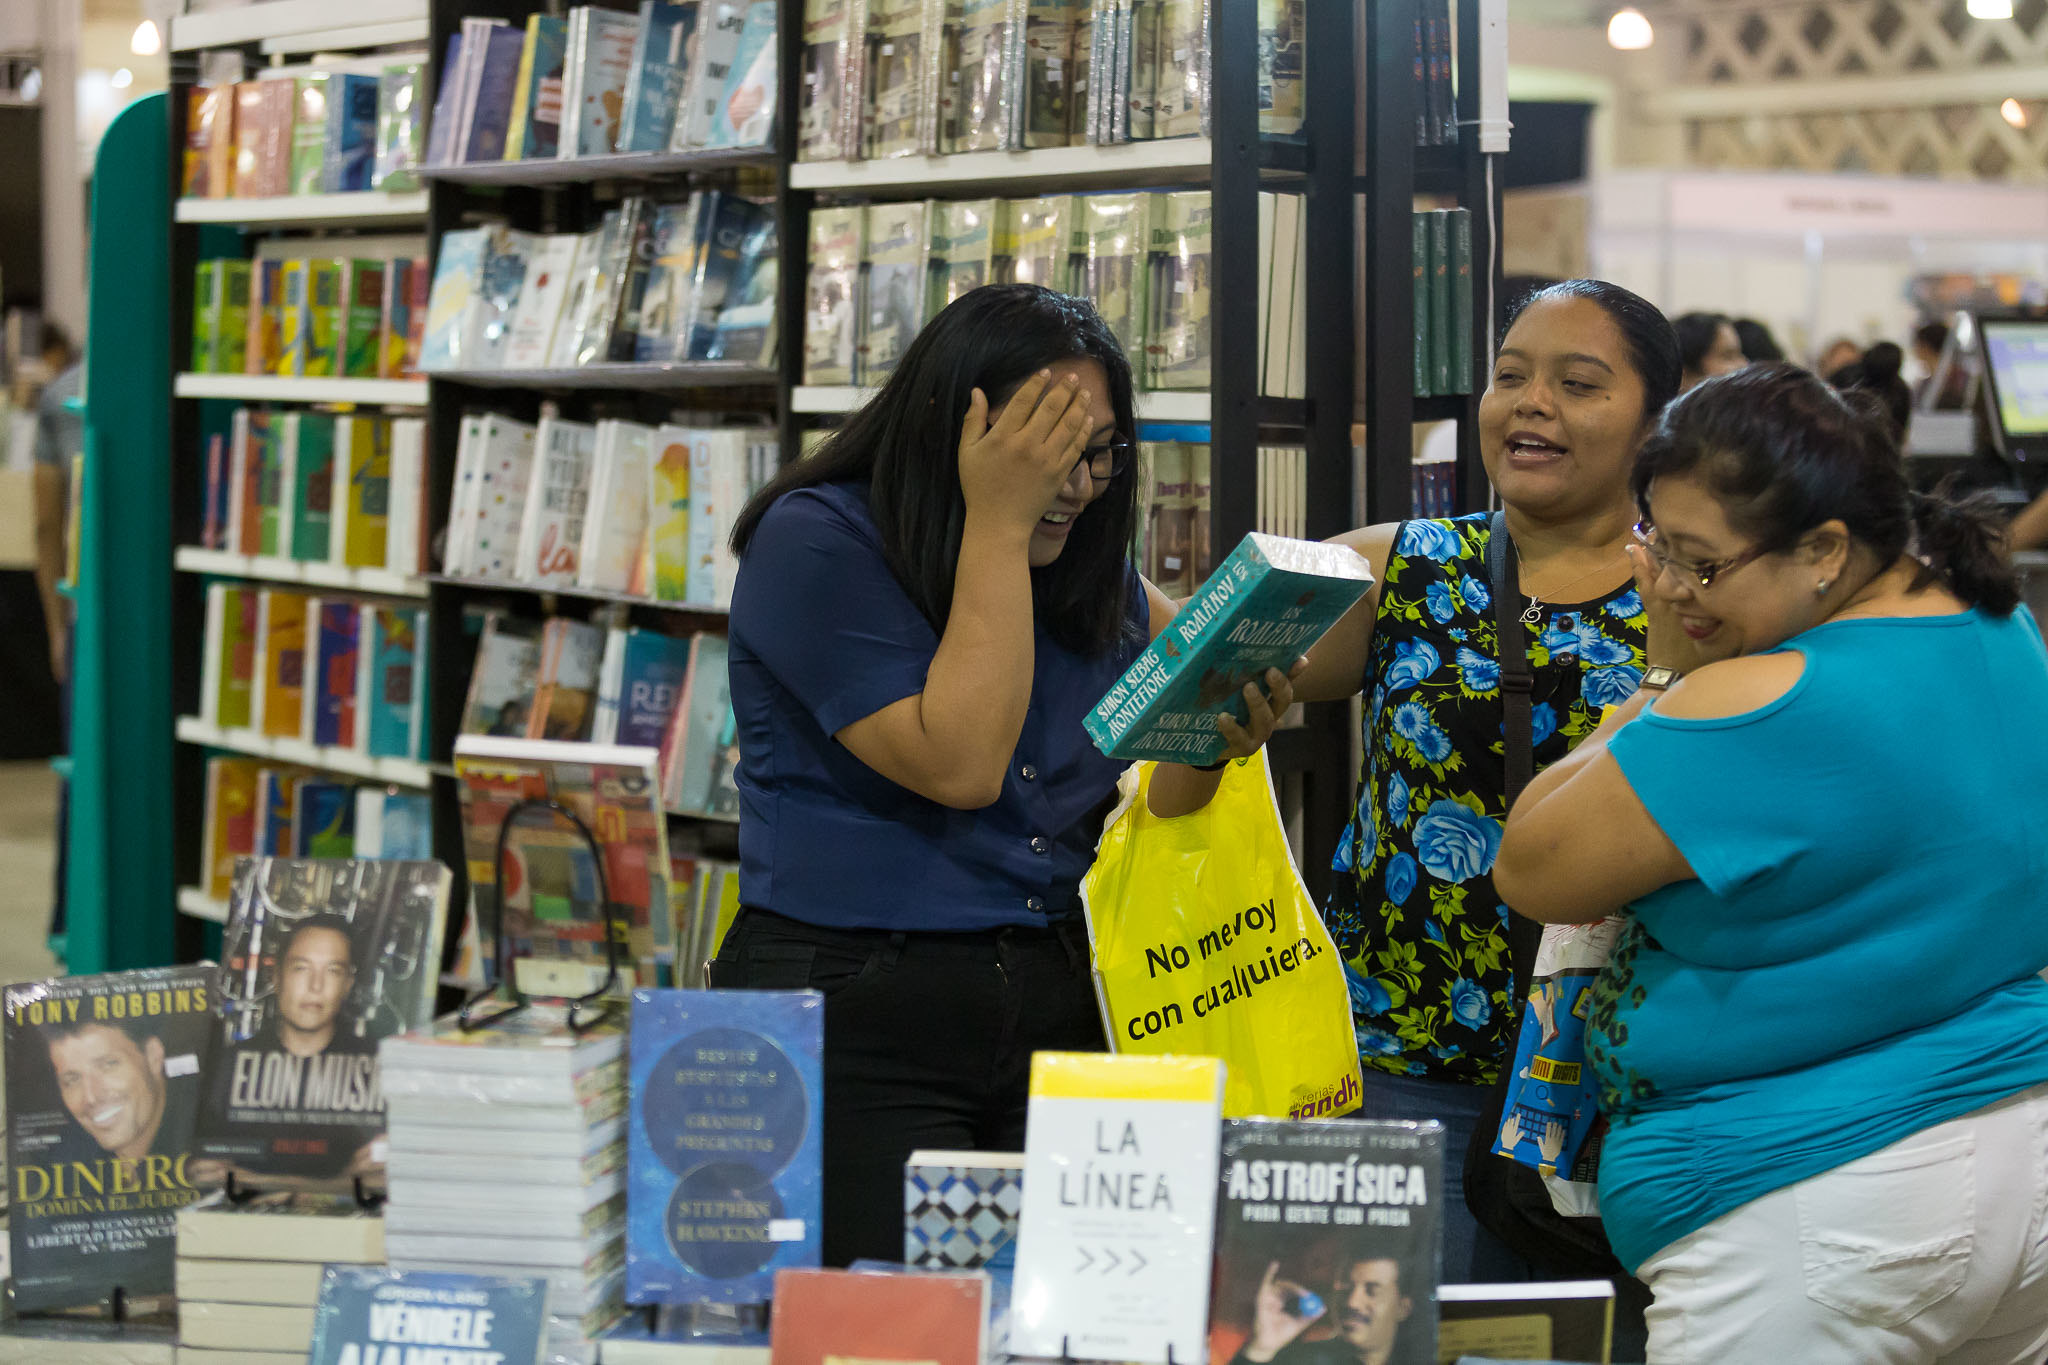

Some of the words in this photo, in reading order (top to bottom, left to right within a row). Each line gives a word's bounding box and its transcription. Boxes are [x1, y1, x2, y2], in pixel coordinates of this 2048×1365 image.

[1097, 682, 1130, 722] SIMON
[1125, 649, 1160, 690] SEBAG
[1107, 663, 1172, 741] MONTEFIORE
[1131, 731, 1218, 754] MONTEFIORE
[1145, 943, 1190, 979] No
[1197, 922, 1235, 961] me
[1233, 898, 1277, 934] voy
[93, 988, 208, 1021] ROBBINS
[1127, 1002, 1184, 1041] con
[230, 1050, 304, 1110] ELON
[1096, 1118, 1142, 1155] LA
[1059, 1160, 1174, 1212] LÍNEA
[1228, 1153, 1428, 1206] ASTROFÍSICA
[1242, 1203, 1281, 1223] PARA
[1284, 1205, 1330, 1225] GENTE
[369, 1302, 496, 1349] VÉNDELE
